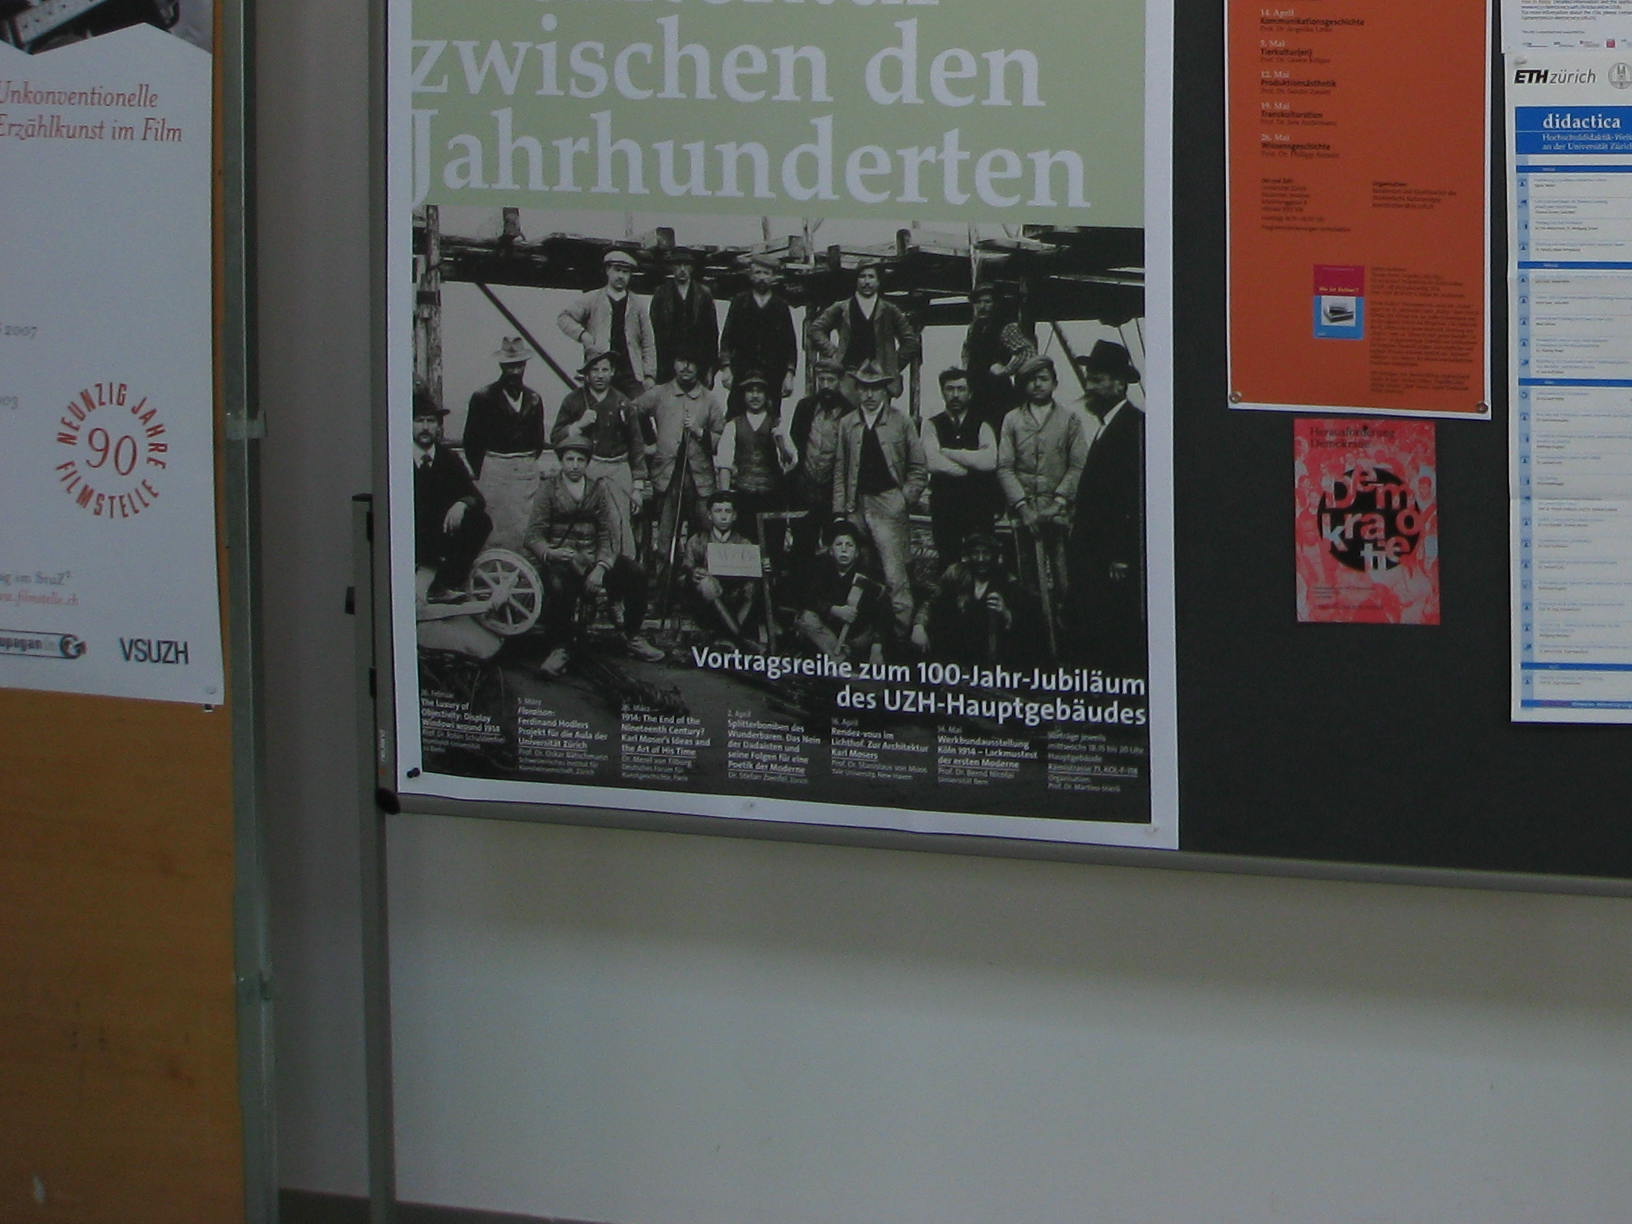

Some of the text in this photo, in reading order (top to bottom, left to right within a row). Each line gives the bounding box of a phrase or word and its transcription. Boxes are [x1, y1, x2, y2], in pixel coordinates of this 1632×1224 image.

[410, 14, 1046, 107] zwischen den
[112, 120, 134, 141] im
[142, 118, 182, 141] Film
[1543, 114, 1621, 129] didactica
[410, 107, 1091, 208] Jahrhunderten
[86, 428, 137, 476] 90
[120, 638, 189, 664] VSUZH
[692, 646, 1145, 696] Vortragsreihe zum 100-Jahr-Jubiläum
[837, 687, 1146, 726] des UZH-Hauptgebäudes
